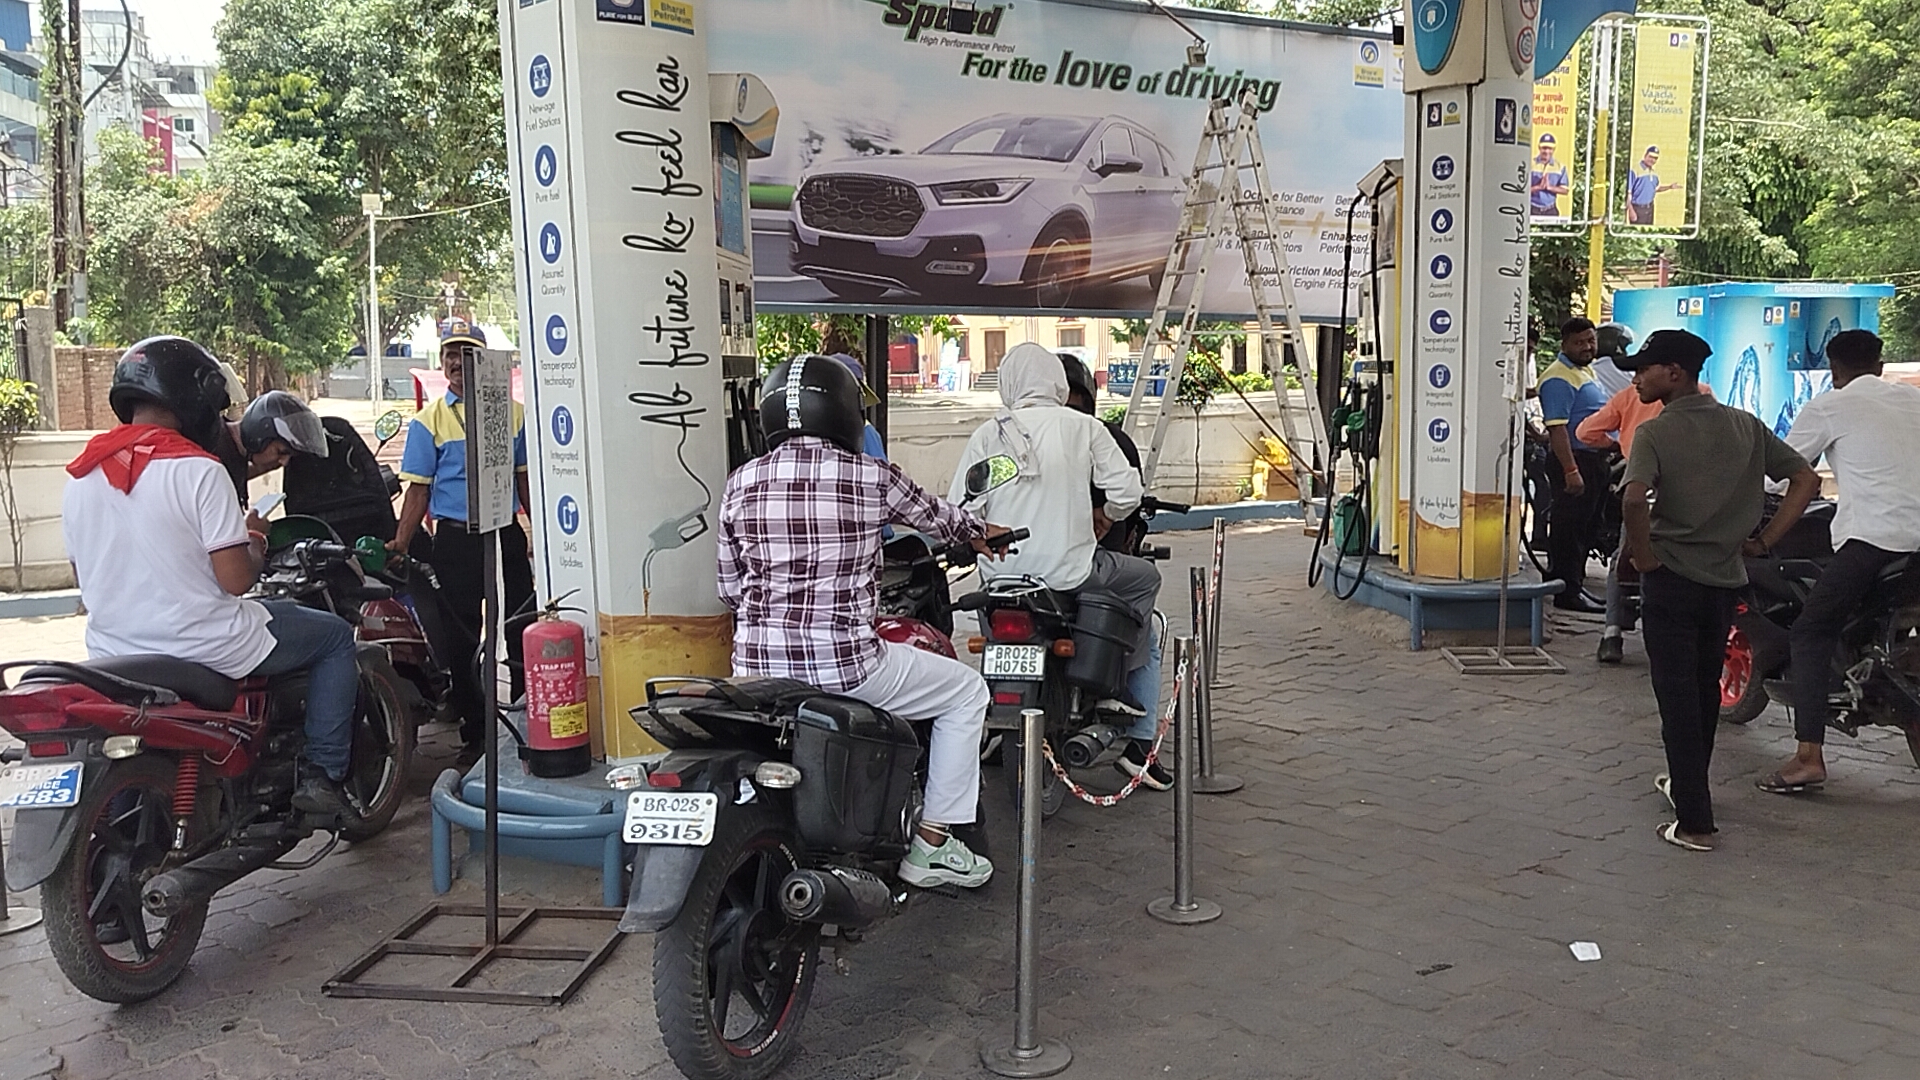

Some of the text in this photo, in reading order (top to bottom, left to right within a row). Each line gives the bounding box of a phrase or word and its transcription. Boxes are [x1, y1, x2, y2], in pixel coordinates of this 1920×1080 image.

[661, 2, 686, 15] Bharat
[653, 10, 693, 24] Petroleum
[919, 35, 1016, 53] High Performance Petrol
[961, 50, 1282, 112] For the love of driving
[525, 118, 538, 132] Fuel
[1500, 160, 1529, 194] kar
[535, 191, 548, 203] Pure
[1281, 192, 1294, 201] for
[1296, 193, 1325, 204] Better
[1498, 203, 1529, 245] feel
[615, 55, 710, 427] Ab future ko feel kar
[1283, 230, 1293, 239] of
[1320, 231, 1368, 242] Enhaced
[1288, 265, 1319, 276] riction
[1498, 253, 1526, 278] ko
[541, 267, 565, 280] Assured
[541, 284, 567, 297] Quantity
[1293, 278, 1326, 290] Engine
[1428, 291, 1454, 300] Quantity
[1425, 346, 1456, 354] technology
[544, 375, 576, 389] technology
[1426, 390, 1454, 398] Integrated
[1426, 400, 1453, 408] Payments
[551, 450, 579, 463] Integrated
[1427, 455, 1451, 464] Updates
[552, 465, 579, 477] Payments
[563, 541, 577, 553] SMS
[559, 556, 584, 569] Updates
[995, 647, 1037, 660] BR02B
[541, 661, 575, 671] TRAP FIRE
[994, 660, 1037, 673] H0765
[643, 797, 700, 812] BR-02S
[630, 823, 703, 840] 9315
